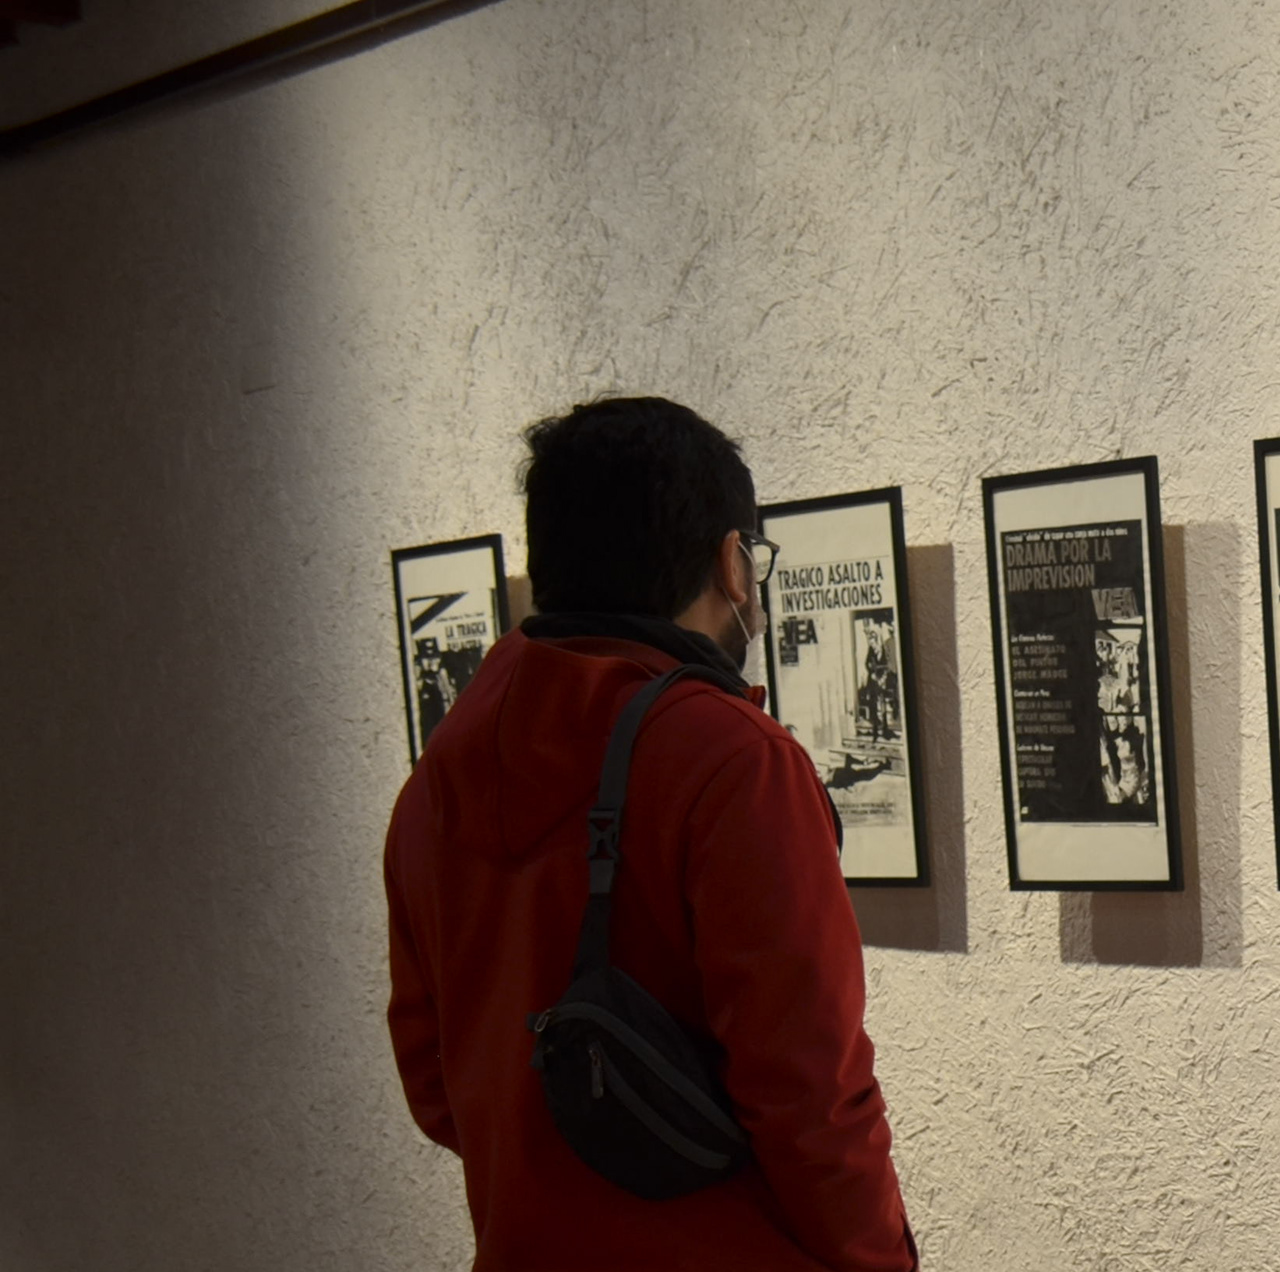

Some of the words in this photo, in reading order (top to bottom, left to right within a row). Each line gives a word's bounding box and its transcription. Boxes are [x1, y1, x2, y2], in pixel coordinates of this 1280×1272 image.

[1006, 541, 1056, 567] DRAMA
[1060, 539, 1090, 563] POR
[1095, 537, 1113, 562] LA
[777, 566, 824, 591] TRAGICO
[828, 561, 871, 585] ASALTO
[875, 560, 884, 581] A
[1008, 564, 1096, 592] IMPREVISION
[782, 583, 883, 614] INVESTIGACIONES
[1091, 587, 1139, 620] VEA
[782, 619, 819, 645] VEA
